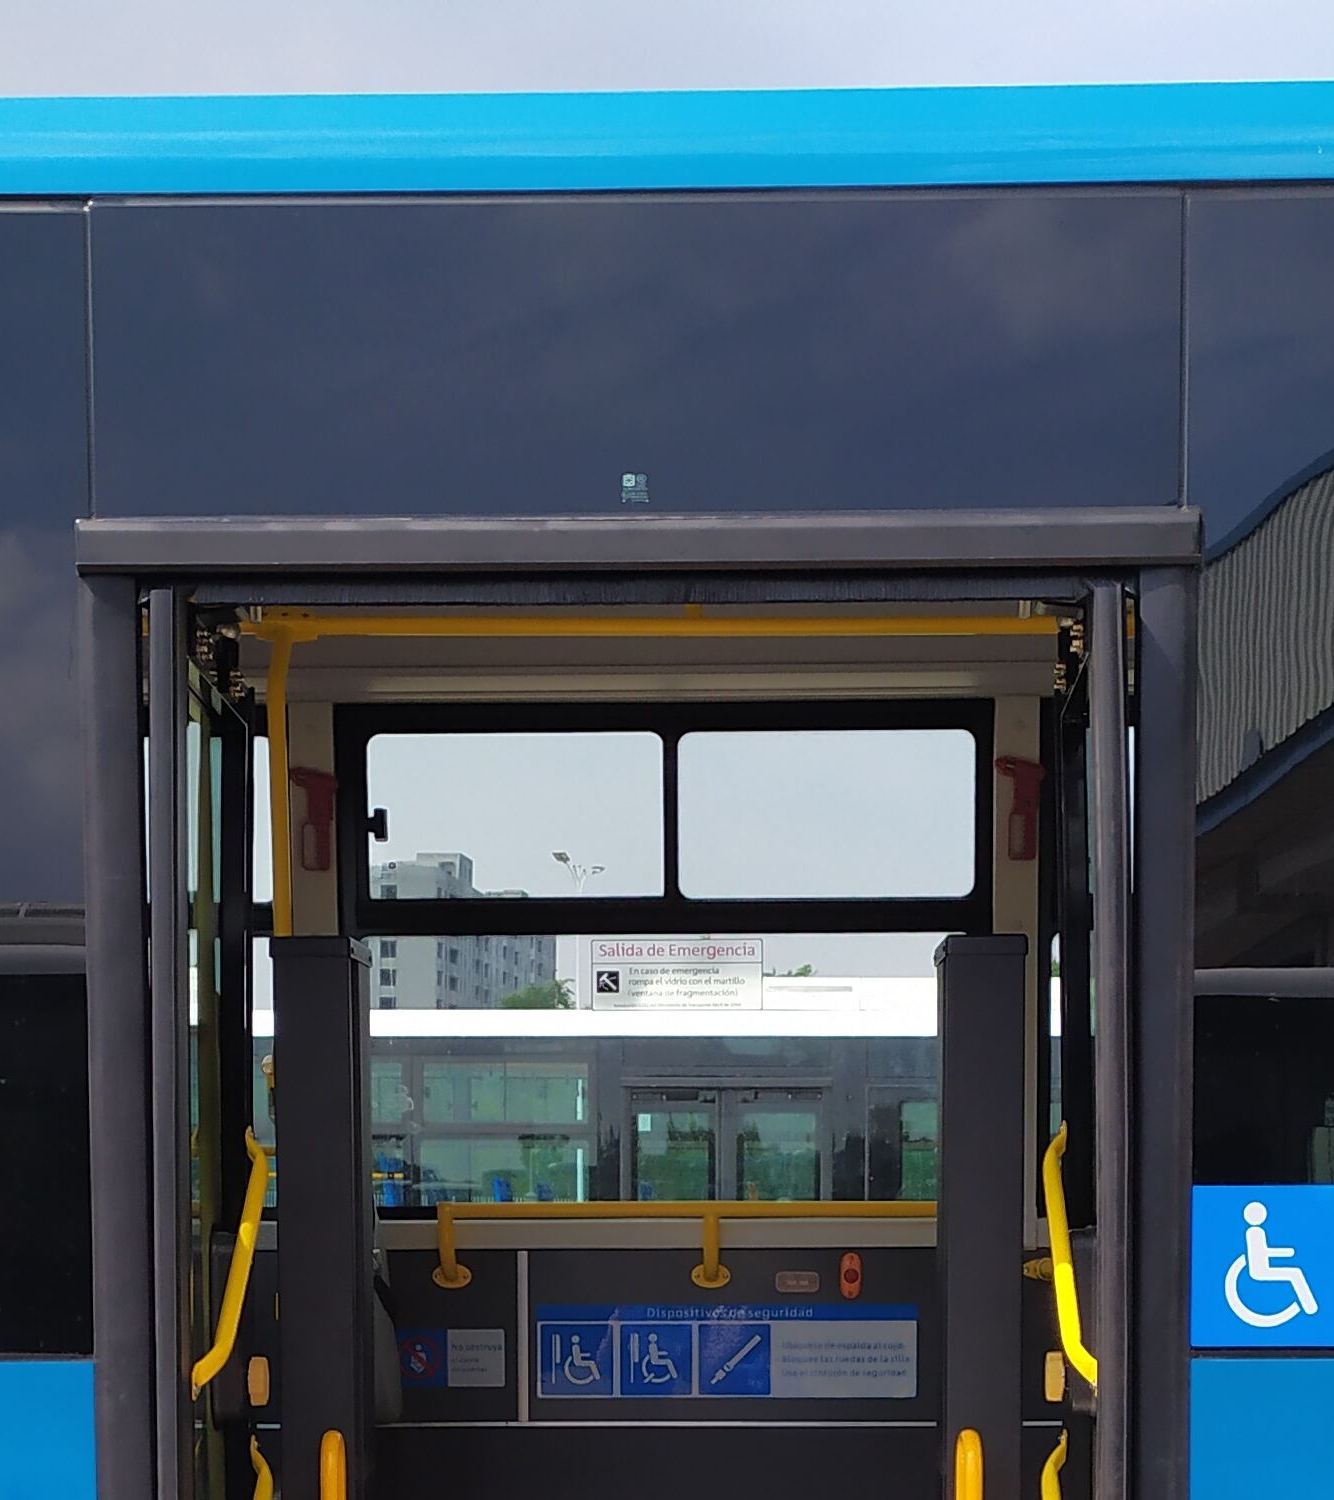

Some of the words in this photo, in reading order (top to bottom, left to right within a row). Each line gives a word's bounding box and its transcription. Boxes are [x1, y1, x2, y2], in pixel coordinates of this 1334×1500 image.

[598, 942, 643, 958] Salida
[647, 942, 665, 957] de
[668, 942, 756, 960] Emergencia
[660, 967, 670, 976] de
[671, 967, 720, 978] emergencia
[714, 977, 746, 986] martillo
[747, 1306, 814, 1322] seguridad
